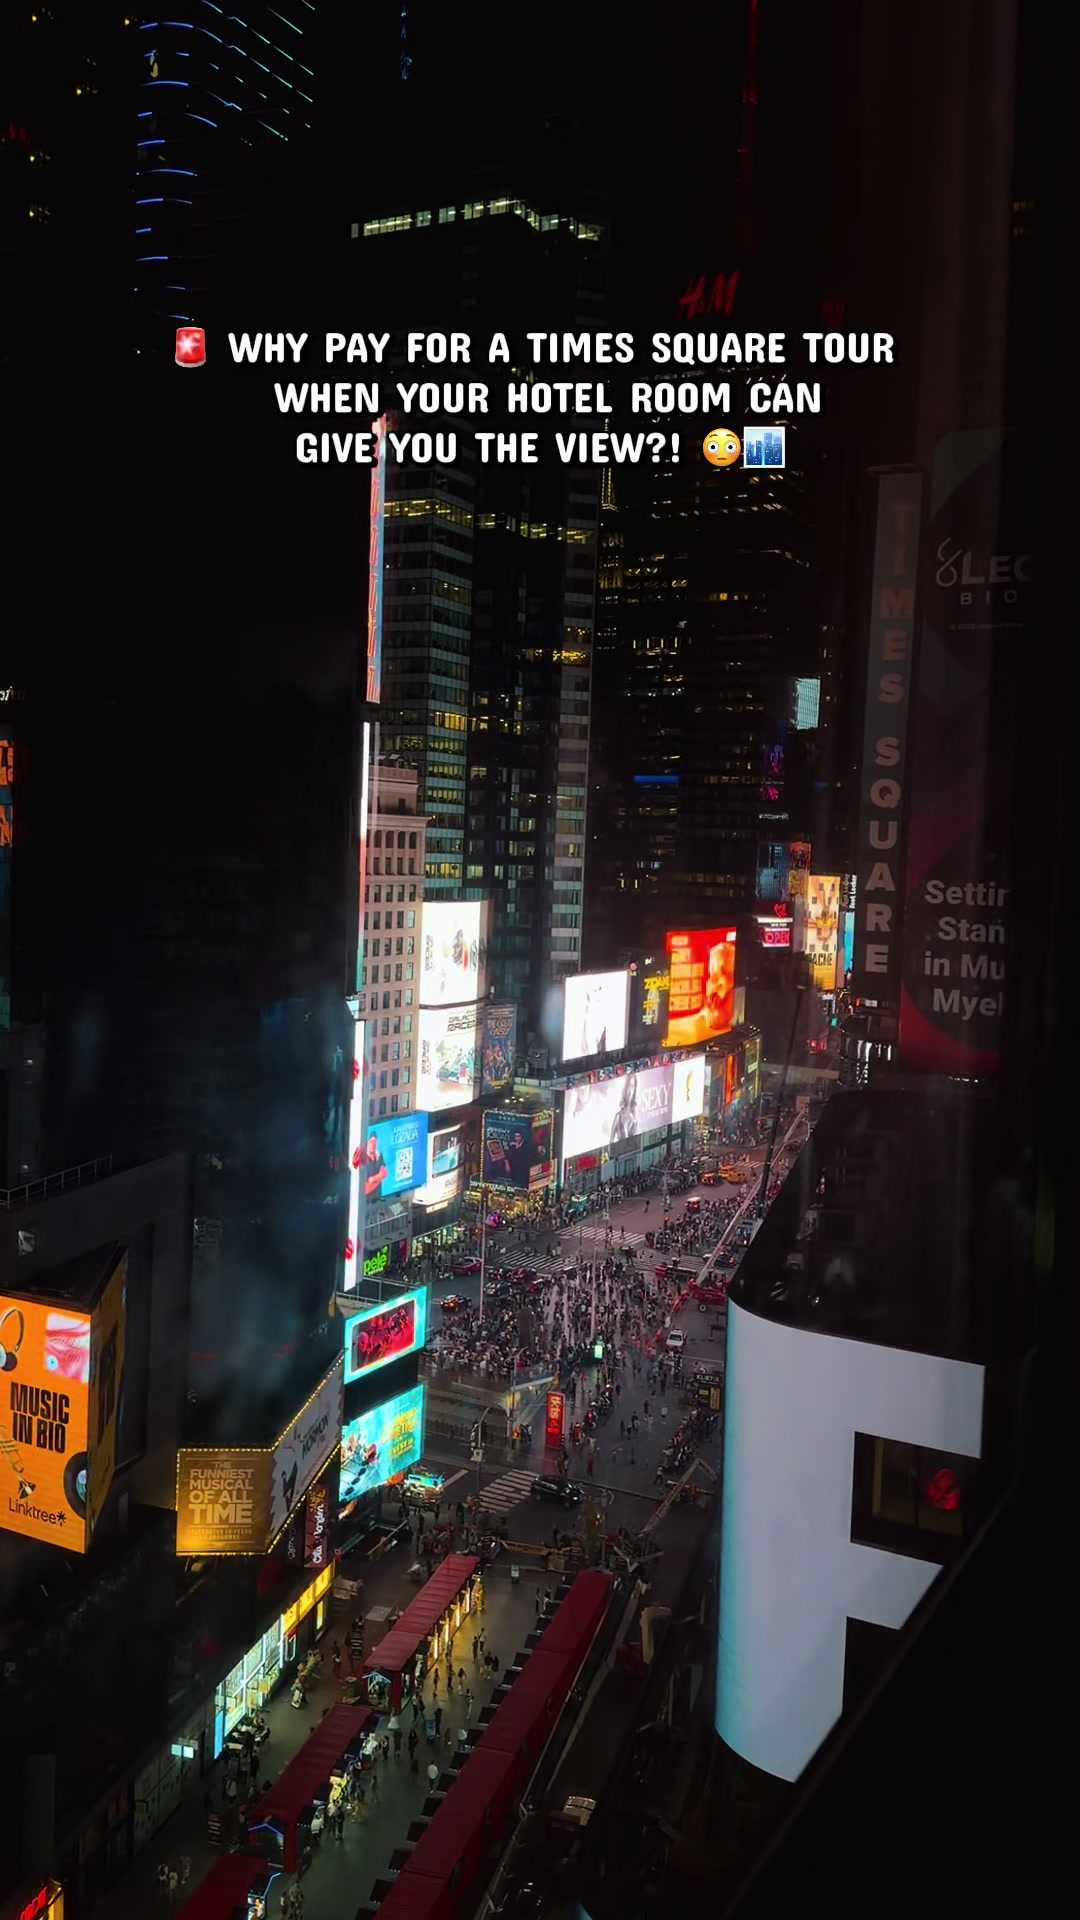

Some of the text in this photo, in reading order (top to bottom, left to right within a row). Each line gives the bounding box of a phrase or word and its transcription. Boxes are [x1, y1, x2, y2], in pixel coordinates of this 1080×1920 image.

[864, 502, 915, 974] TIMES SQUARE
[924, 951, 950, 977] in
[641, 1083, 672, 1111] SEXY
[10, 1381, 71, 1424] MUSIC
[12, 1411, 67, 1454] IN BIO
[190, 1469, 254, 1479] FUNNIEST
[211, 1461, 232, 1469] THE
[189, 1479, 254, 1490] MUSICAL
[189, 1490, 254, 1504] OF ALL
[8, 1496, 57, 1525] Linktree
[188, 1503, 254, 1524] TIME
